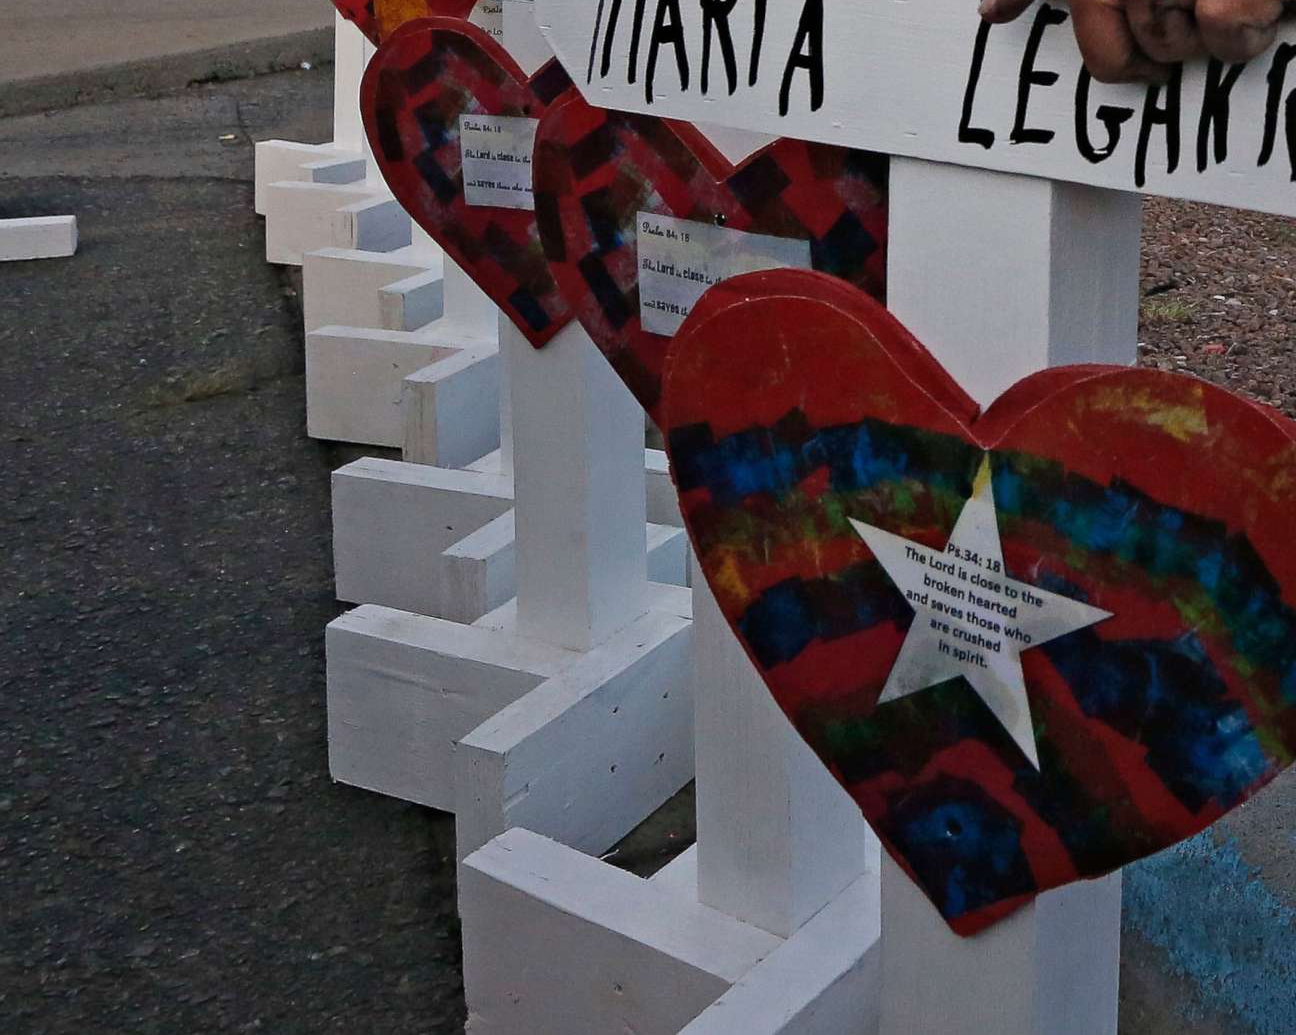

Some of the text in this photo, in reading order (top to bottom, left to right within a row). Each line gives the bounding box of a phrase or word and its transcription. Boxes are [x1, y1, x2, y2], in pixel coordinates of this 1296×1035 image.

[476, 150, 490, 160] Lord
[497, 151, 514, 162] close
[680, 232, 690, 243] 18
[656, 260, 674, 276] Lord
[683, 267, 704, 283] close
[656, 300, 679, 314] saves
[905, 546, 1043, 607] The Lord is close to the
[986, 558, 1001, 573] 18
[923, 573, 1017, 618] broken hearted
[906, 589, 1031, 644] and saves those who
[930, 619, 1001, 653] are crushed
[938, 639, 988, 668] in spirit.
